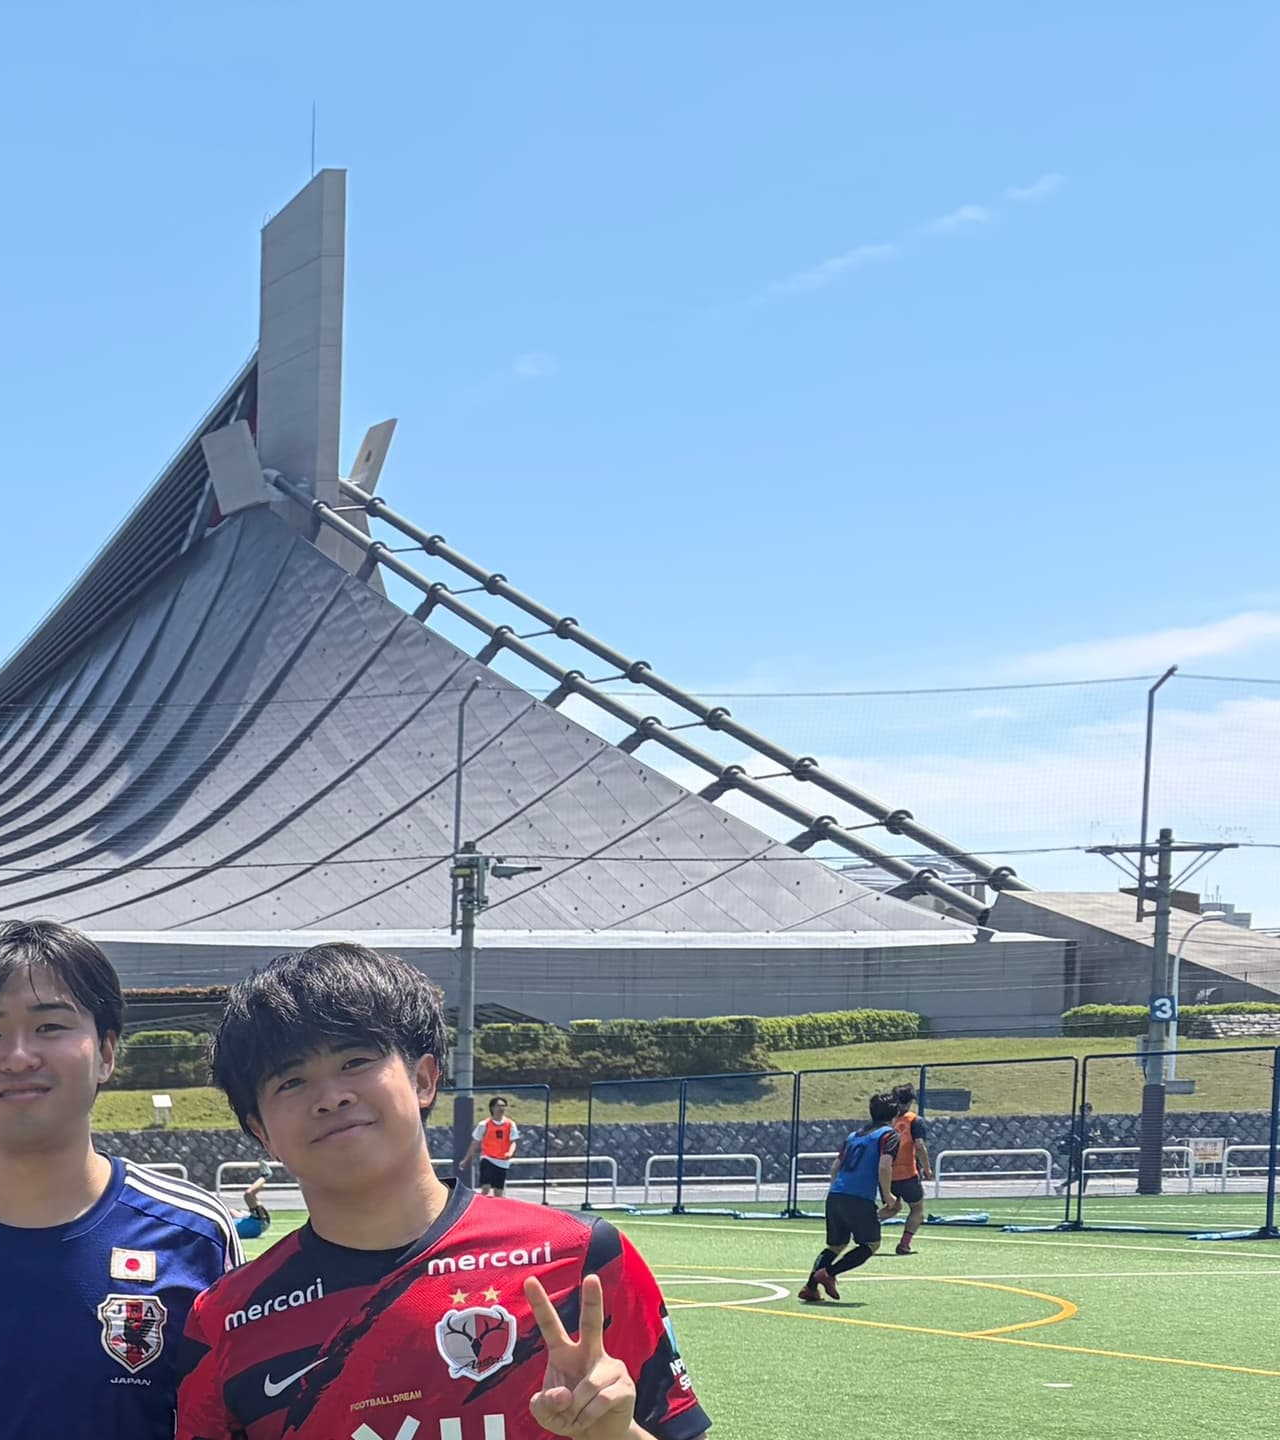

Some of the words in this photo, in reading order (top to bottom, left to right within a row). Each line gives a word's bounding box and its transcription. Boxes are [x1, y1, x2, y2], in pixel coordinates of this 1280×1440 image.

[1153, 998, 1173, 1019] 3
[428, 1242, 552, 1276] mercari
[223, 1277, 324, 1332] mercari
[109, 1376, 152, 1387] JAPAN
[350, 1395, 392, 1412] FOOTBALL
[393, 1389, 422, 1403] DREAM
